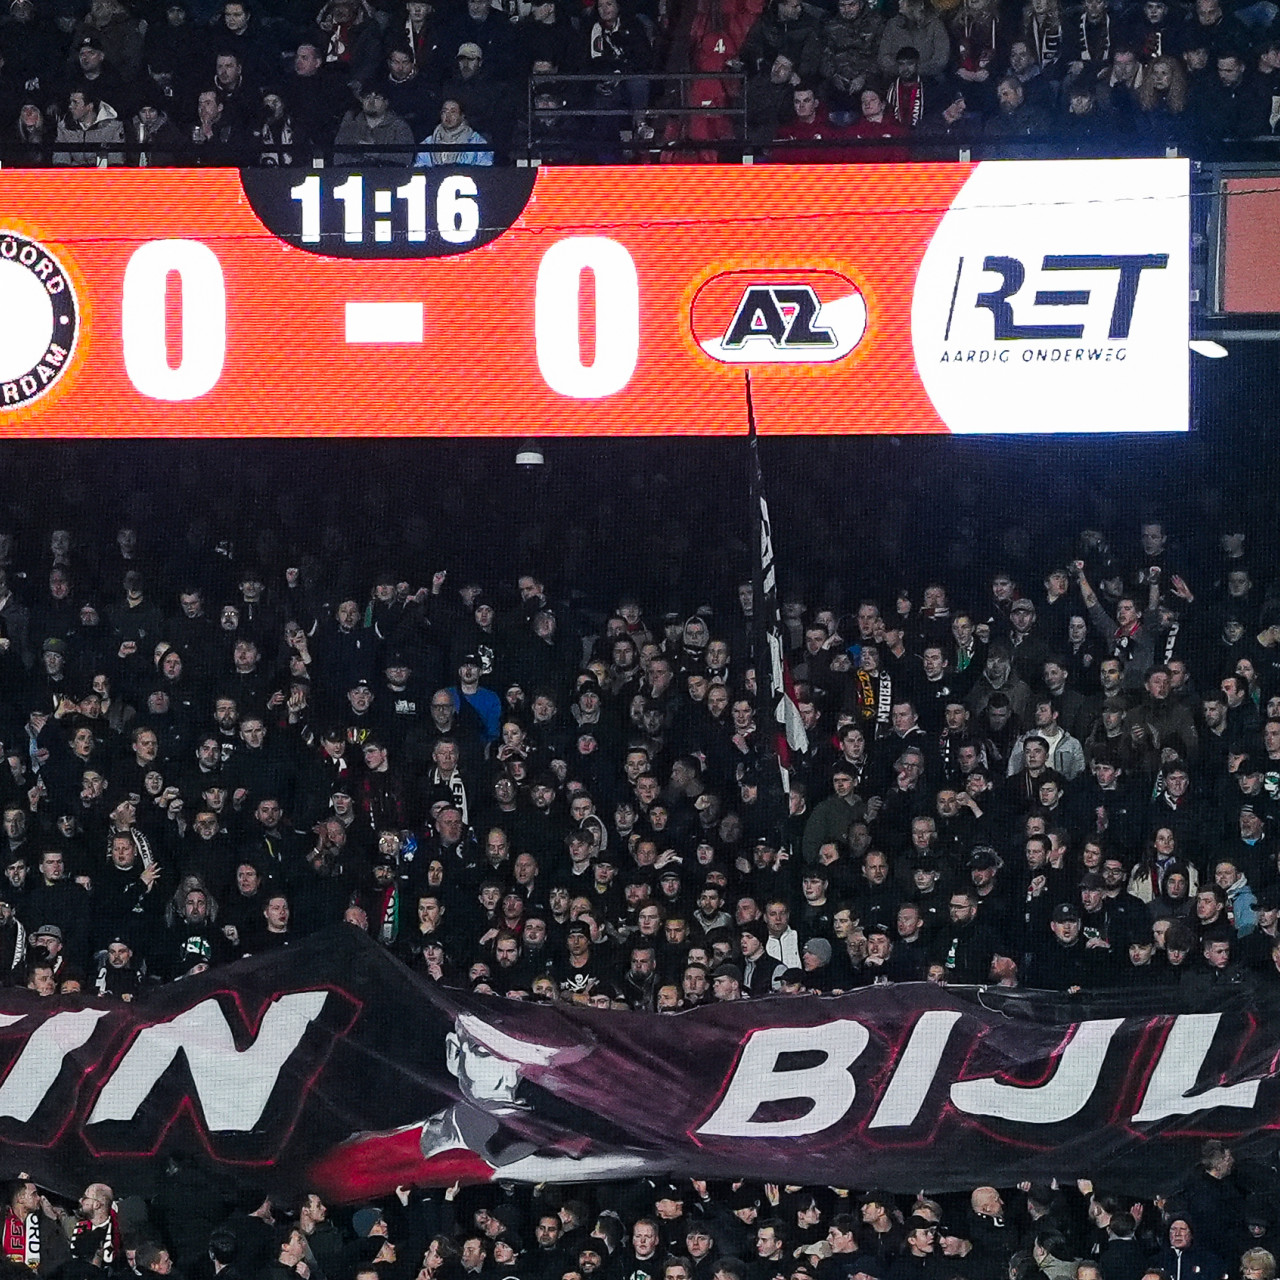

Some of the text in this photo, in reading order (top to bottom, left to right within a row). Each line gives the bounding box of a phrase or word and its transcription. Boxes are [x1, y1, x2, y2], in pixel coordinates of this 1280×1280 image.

[291, 175, 478, 243] 11:16
[123, 239, 225, 401] 0
[534, 234, 640, 399] 0
[720, 282, 842, 350] AZ
[975, 254, 1169, 341] RET
